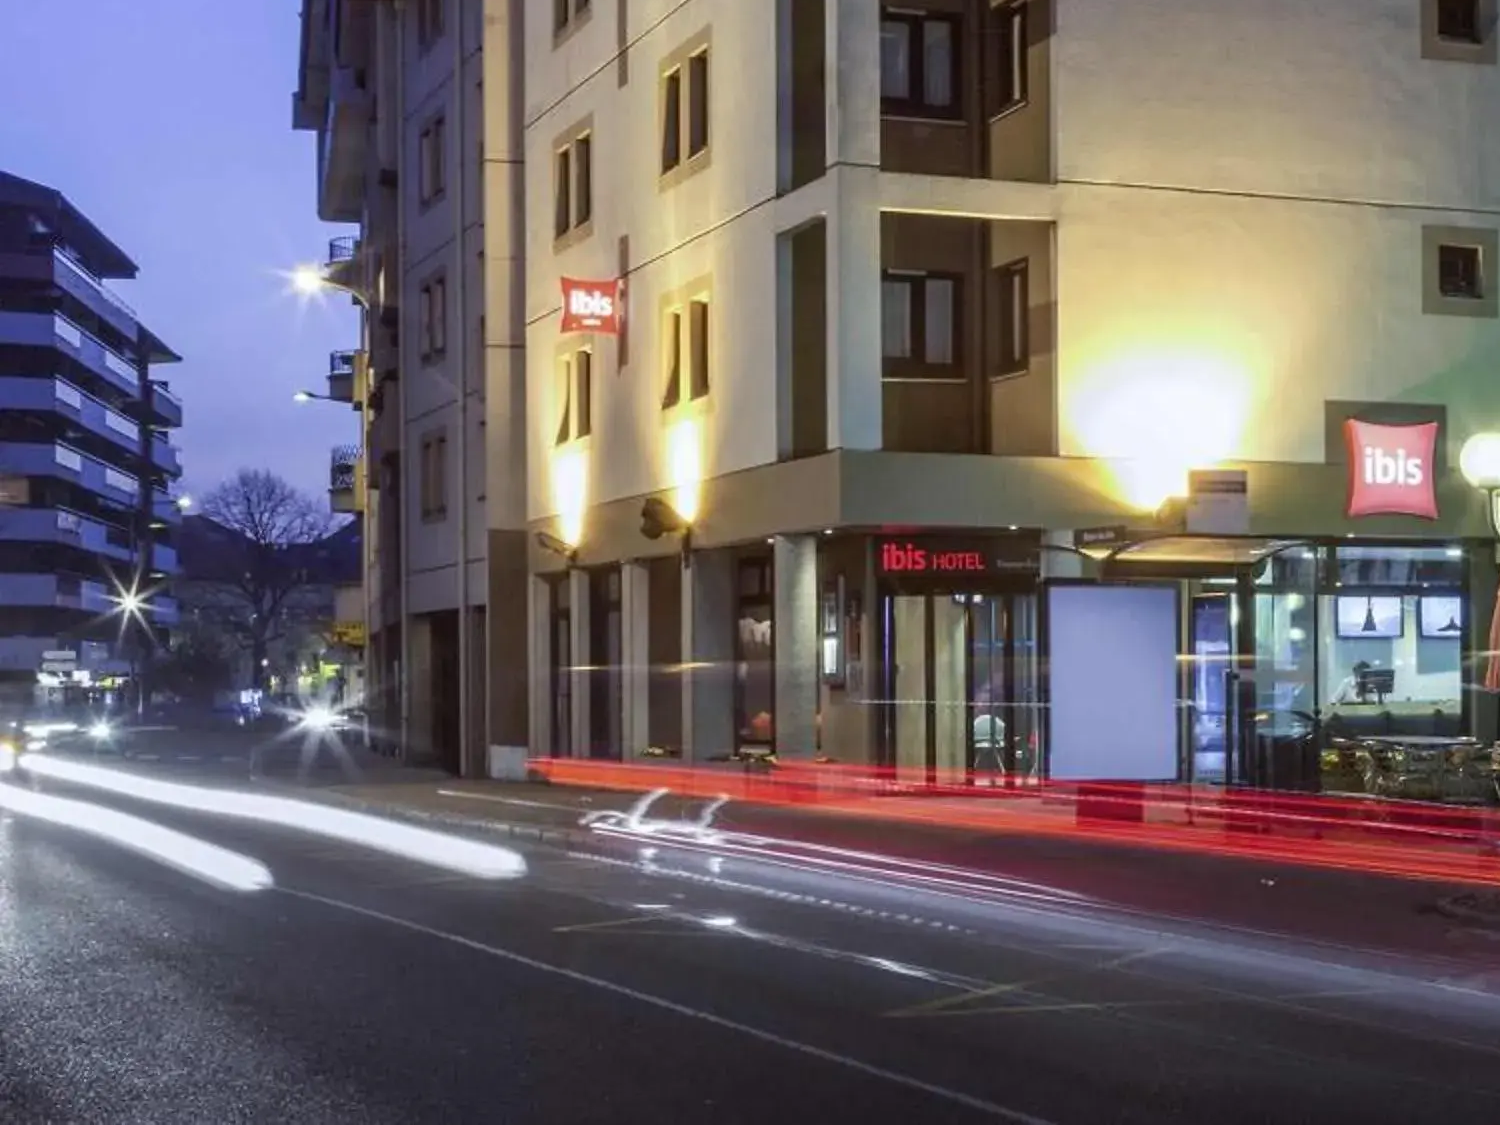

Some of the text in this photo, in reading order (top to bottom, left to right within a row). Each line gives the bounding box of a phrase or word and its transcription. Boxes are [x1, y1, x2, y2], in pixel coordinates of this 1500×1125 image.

[570, 289, 612, 315] ibis
[1365, 446, 1423, 485] ibis
[882, 543, 927, 571] ibis
[932, 552, 985, 571] HOTEL
